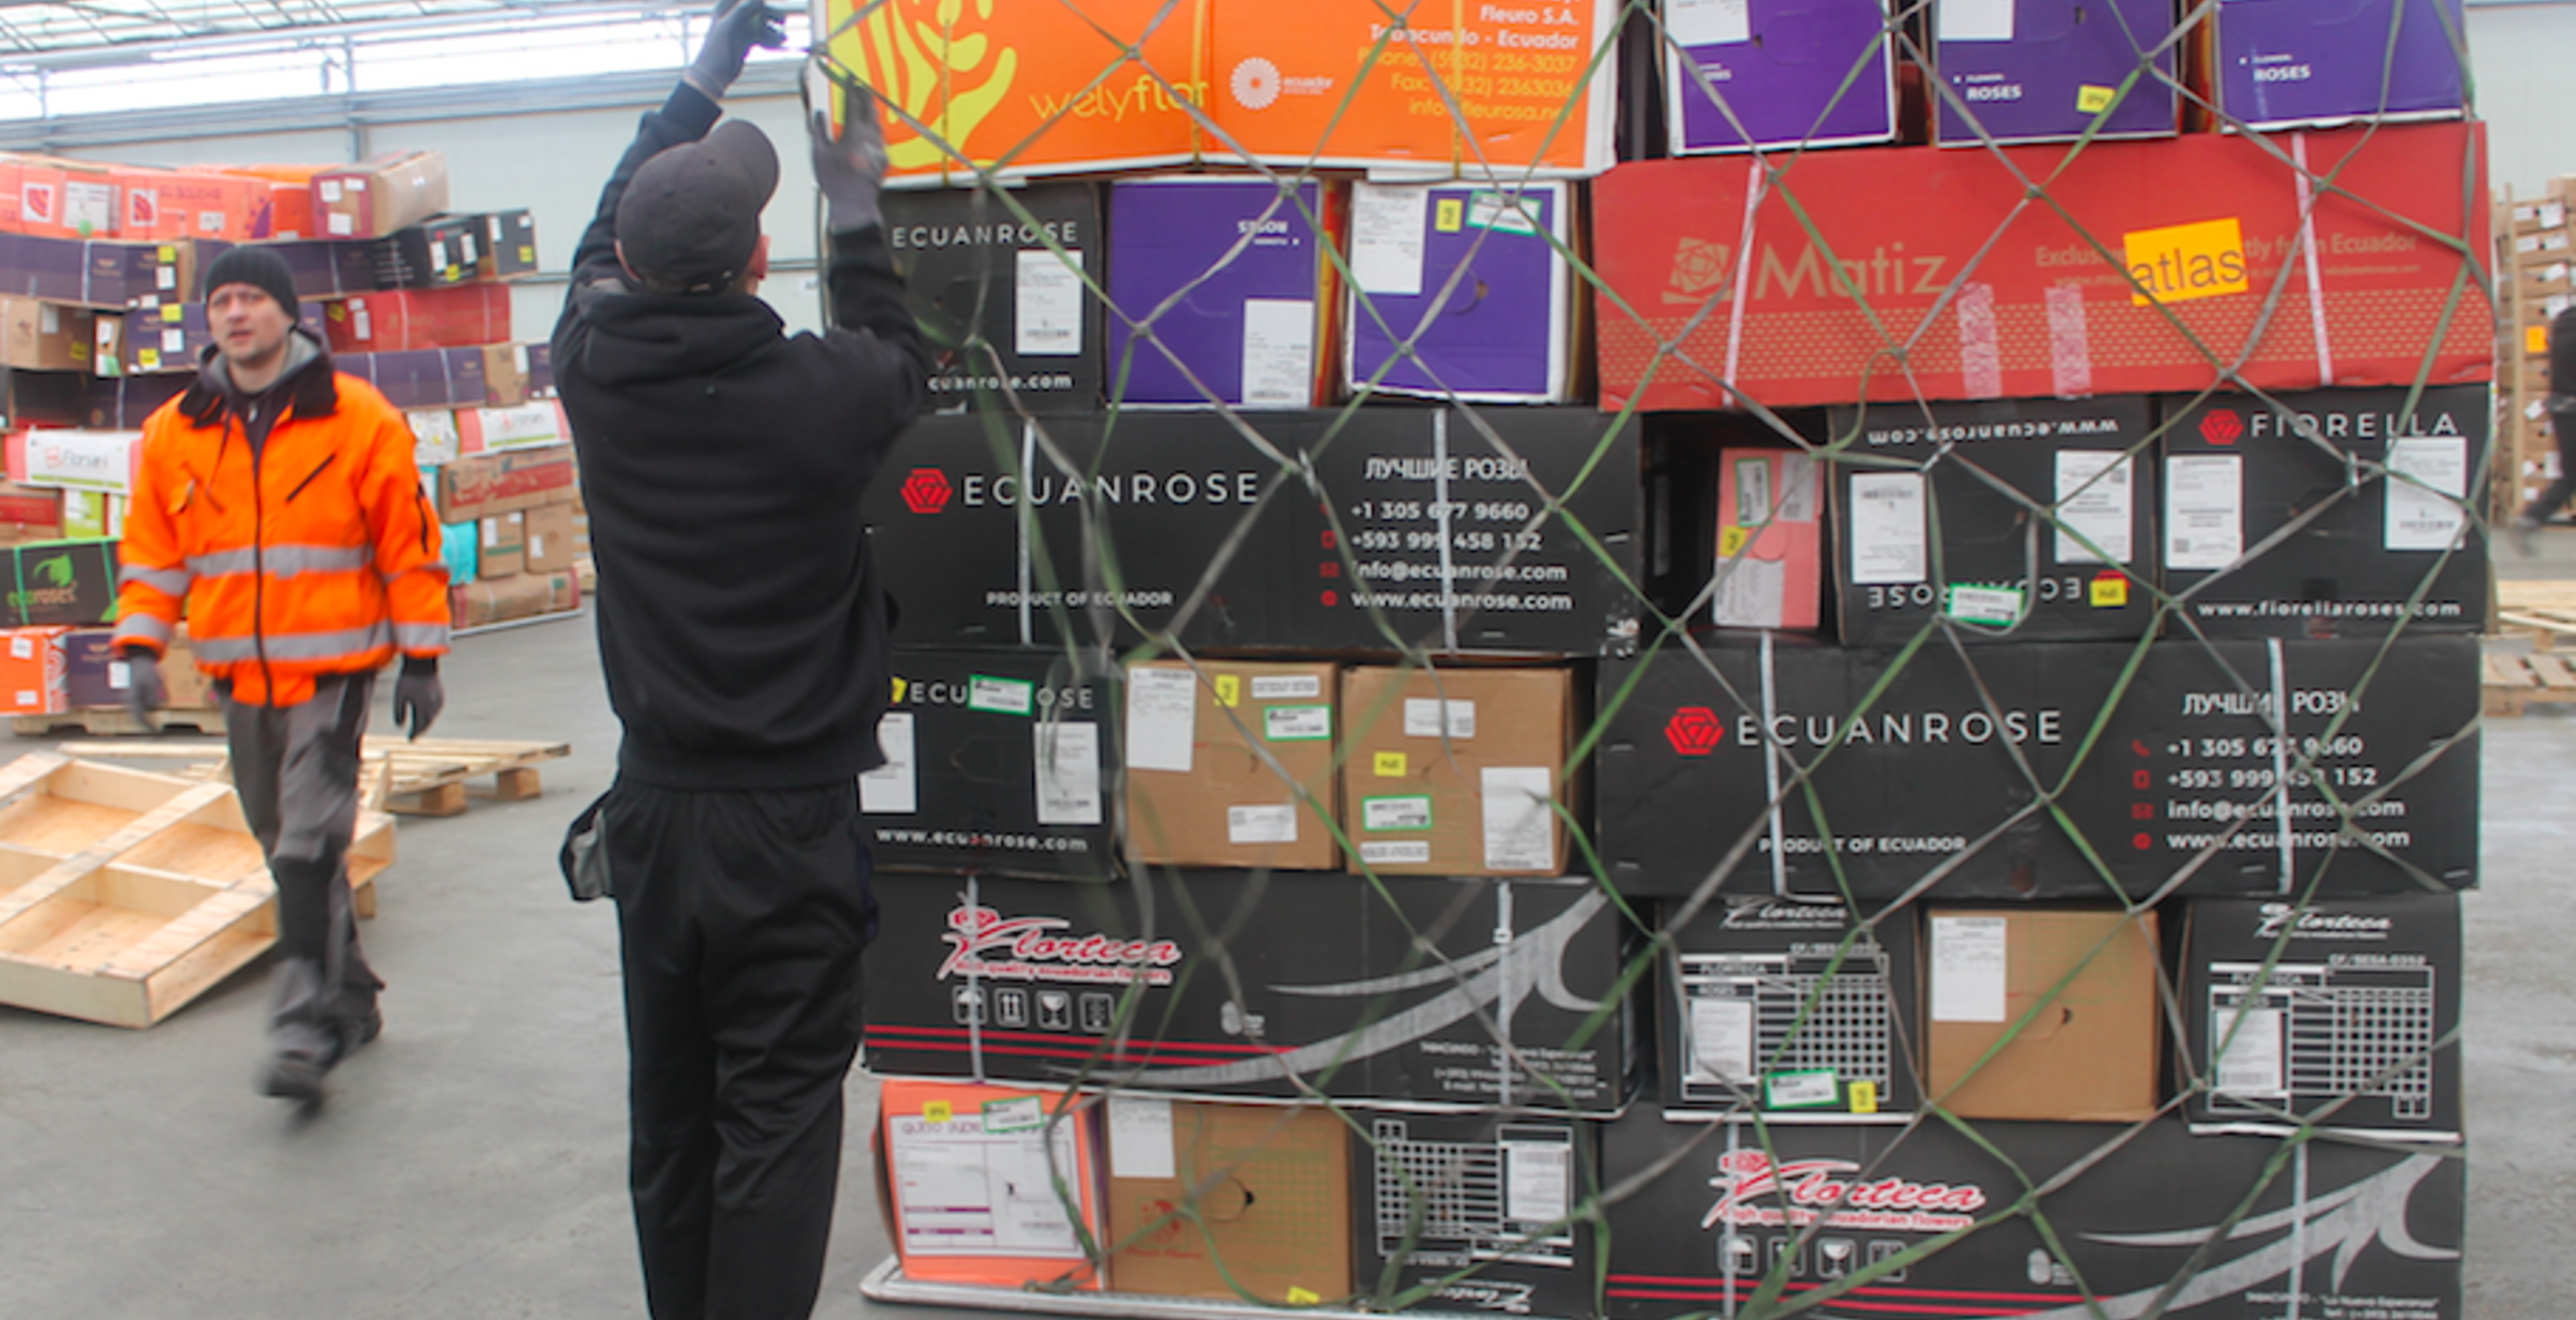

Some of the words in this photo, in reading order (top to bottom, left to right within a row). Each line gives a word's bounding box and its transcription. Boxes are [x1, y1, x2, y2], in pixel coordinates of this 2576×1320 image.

[1480, 6, 1538, 23] Fleuro
[1543, 8, 1579, 25] S.A.
[1498, 30, 1578, 49] Ecuador
[1431, 50, 1487, 72] (532)
[1492, 53, 1577, 73] 236-3037
[2252, 65, 2311, 82] ROSES
[1029, 74, 1209, 122] welyflor
[1966, 85, 2022, 100] ROSES
[892, 221, 1078, 248] ECUANROSE
[2330, 230, 2419, 254] Ecuador
[1755, 241, 1951, 300] Matiz
[2130, 247, 2248, 297] atlas
[2251, 412, 2459, 438] FIORELLA
[963, 473, 1260, 505] ECUANROSE
[1351, 502, 1373, 519] +1
[1381, 502, 1420, 519] 305
[1474, 502, 1530, 519] 9660
[1351, 530, 1400, 549] +593
[1453, 532, 1494, 550] 458
[1066, 591, 1090, 606] OF
[1351, 592, 1573, 610] www.ecunrose.com
[2197, 600, 2462, 617] www.fiorellarosescom
[909, 681, 1094, 709] ECUOSE
[1737, 710, 2062, 747] ECUANROSE
[2167, 739, 2192, 756] +1
[2201, 739, 2246, 756] 305
[2303, 736, 2364, 756] 960
[2167, 769, 2223, 788] +593
[2230, 769, 2274, 788] 999
[2334, 767, 2379, 786] 152
[876, 829, 1088, 851] www.ecuanrose.com
[1848, 838, 1873, 852] OF
[1878, 836, 1968, 852] ECUADOR
